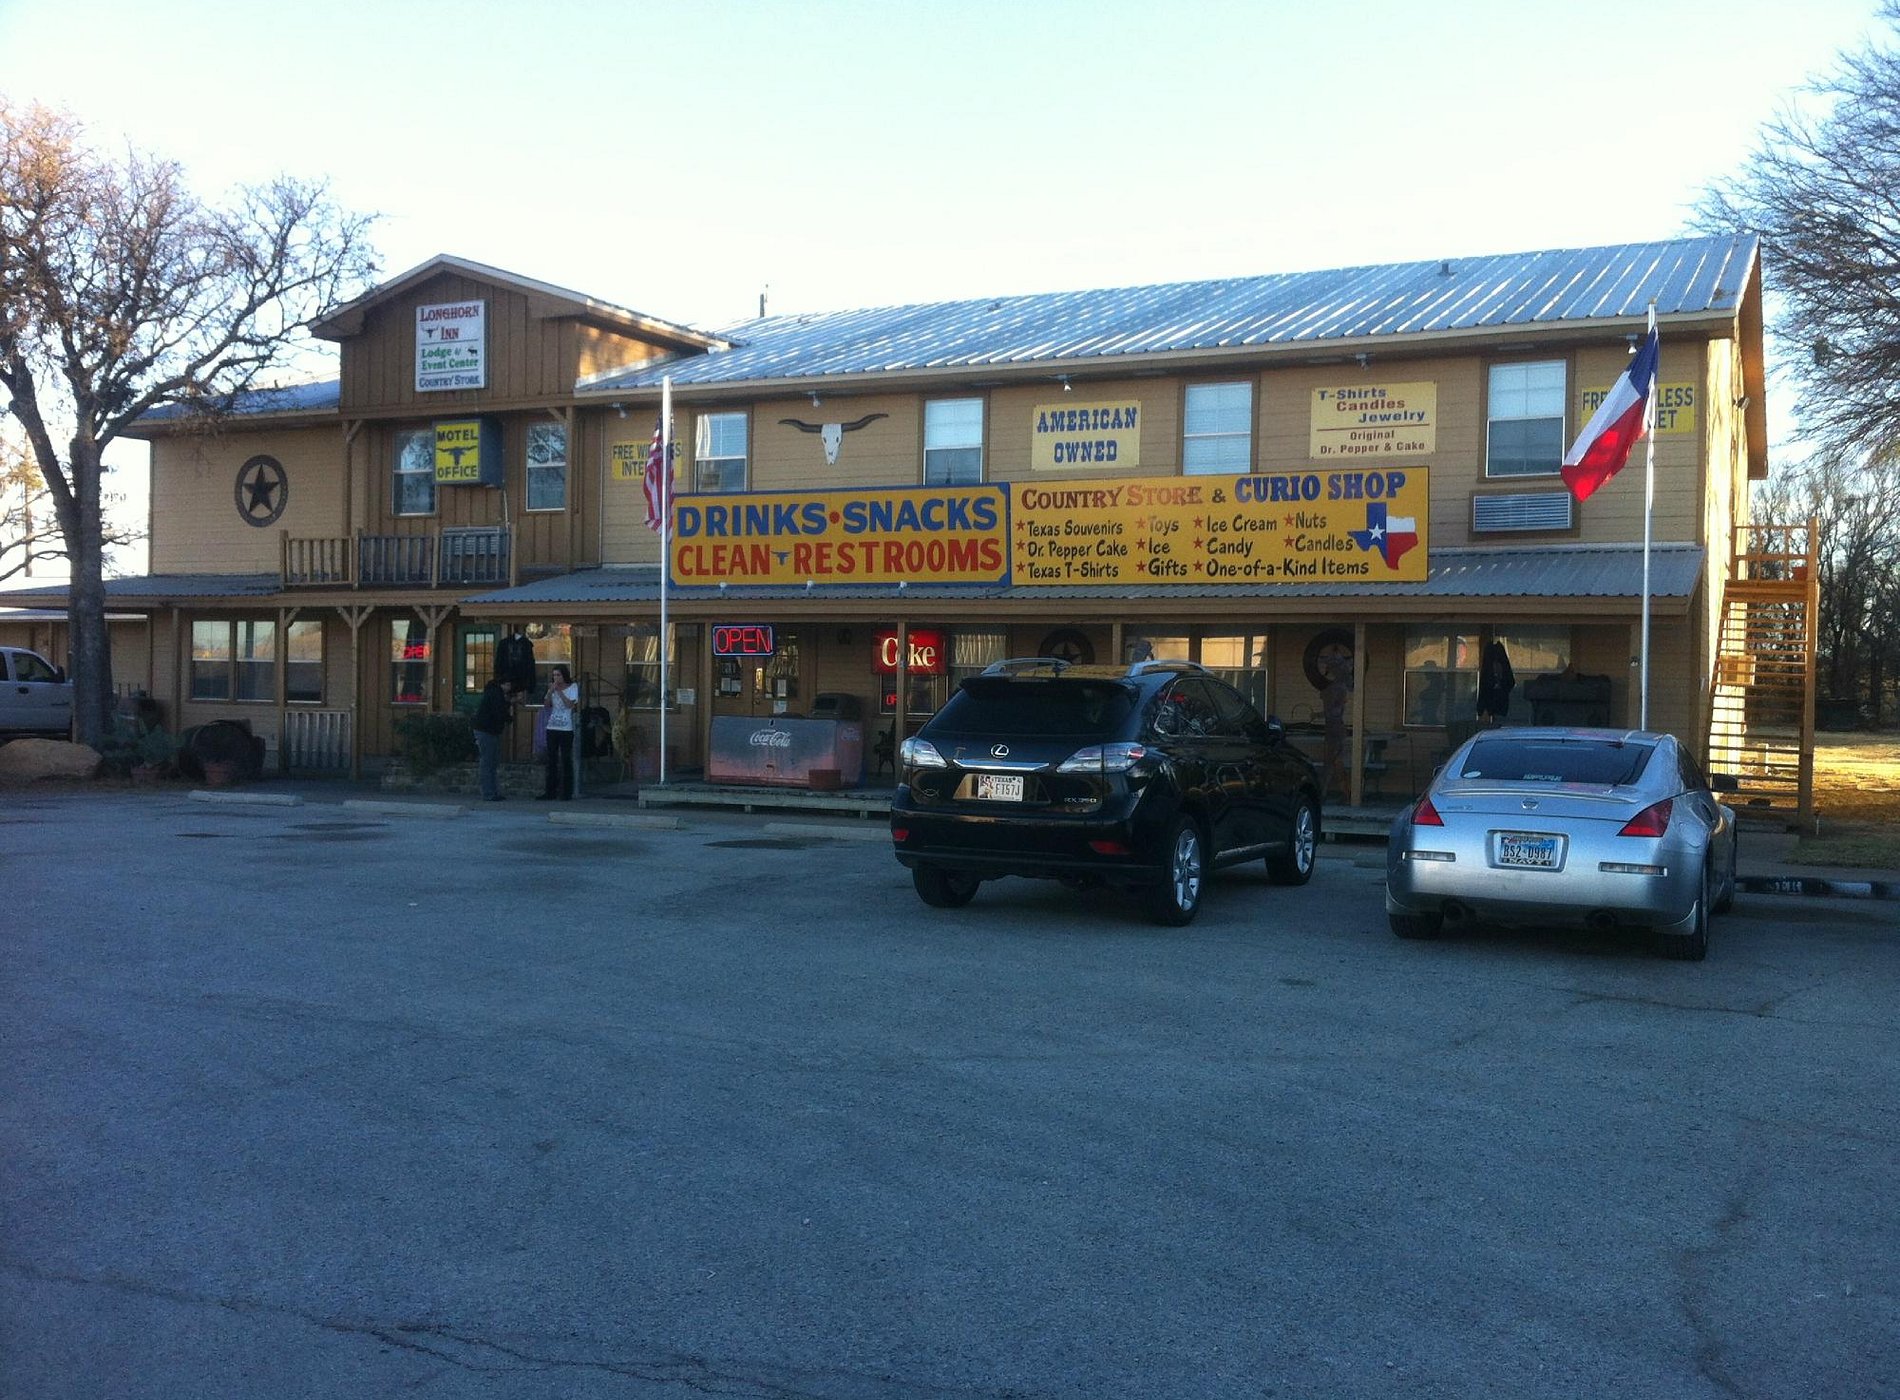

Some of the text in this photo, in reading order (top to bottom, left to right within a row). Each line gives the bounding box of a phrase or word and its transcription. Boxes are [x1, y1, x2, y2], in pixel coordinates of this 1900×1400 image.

[420, 305, 479, 322] LONGHORN
[441, 326, 459, 340] INN
[421, 347, 452, 358] Lodge
[421, 359, 478, 370] Event Center
[1318, 387, 1387, 400] T-Shirts
[1336, 400, 1406, 412] Candles
[1037, 406, 1137, 433] AMERICAN
[1358, 410, 1425, 423] Jewelry
[437, 428, 478, 442] MOTEL
[1350, 430, 1395, 441] Original
[1054, 440, 1117, 463] OWNED
[1320, 441, 1425, 455] Dr. Pepper & Cake
[437, 465, 477, 478] OFFICE
[1021, 471, 1406, 510] COUNTRY STORE & CURIO SHOP
[677, 496, 998, 538] DRINKS SNACKS
[1149, 515, 1180, 536] Toys
[1207, 514, 1278, 532] Ice Cream
[1295, 511, 1327, 529] Nuts
[1027, 519, 1123, 537] Texas Souvenirs
[1027, 539, 1128, 560] Dr. Pepper Cake
[1148, 537, 1171, 554] Ice
[1206, 537, 1253, 558] Candy
[1295, 534, 1354, 552] Candles
[678, 537, 1002, 576] CLEAN RESTROOMS
[1027, 561, 1119, 579] Texas T-Shirts
[1148, 558, 1188, 576] Gifts
[1206, 558, 1369, 577] One-of-a-Kind Items
[715, 627, 770, 653] OPEN
